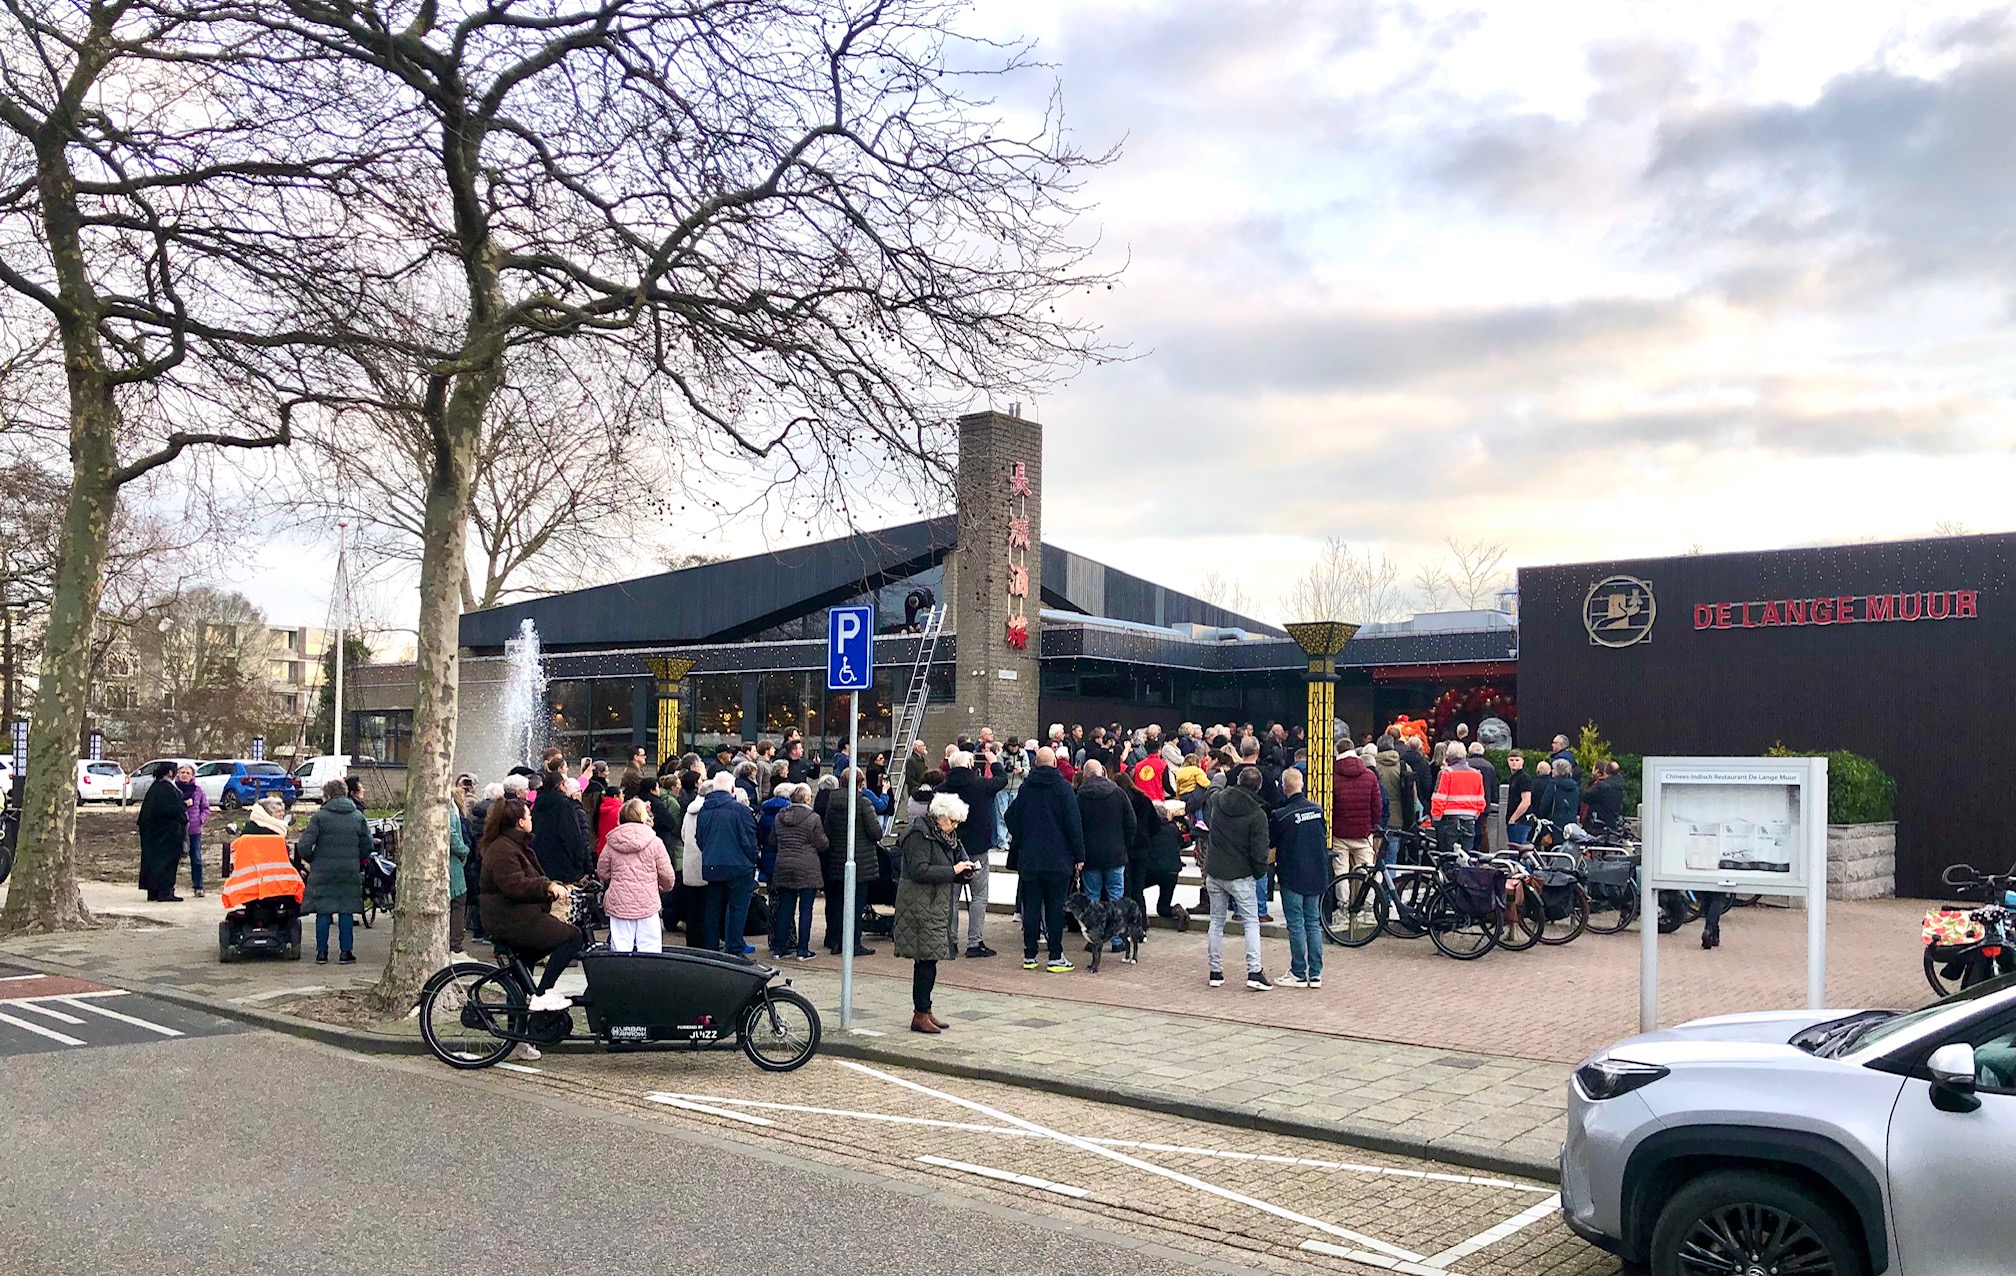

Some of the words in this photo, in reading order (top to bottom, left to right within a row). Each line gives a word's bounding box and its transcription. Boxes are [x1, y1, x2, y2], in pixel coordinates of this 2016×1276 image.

[1693, 602, 1732, 630] DE
[1742, 596, 1855, 629] LANGE
[1865, 590, 1979, 622] MUUR
[837, 611, 861, 655] P
[1713, 773, 1747, 781] Restaurant
[1758, 774, 1779, 783] Lange
